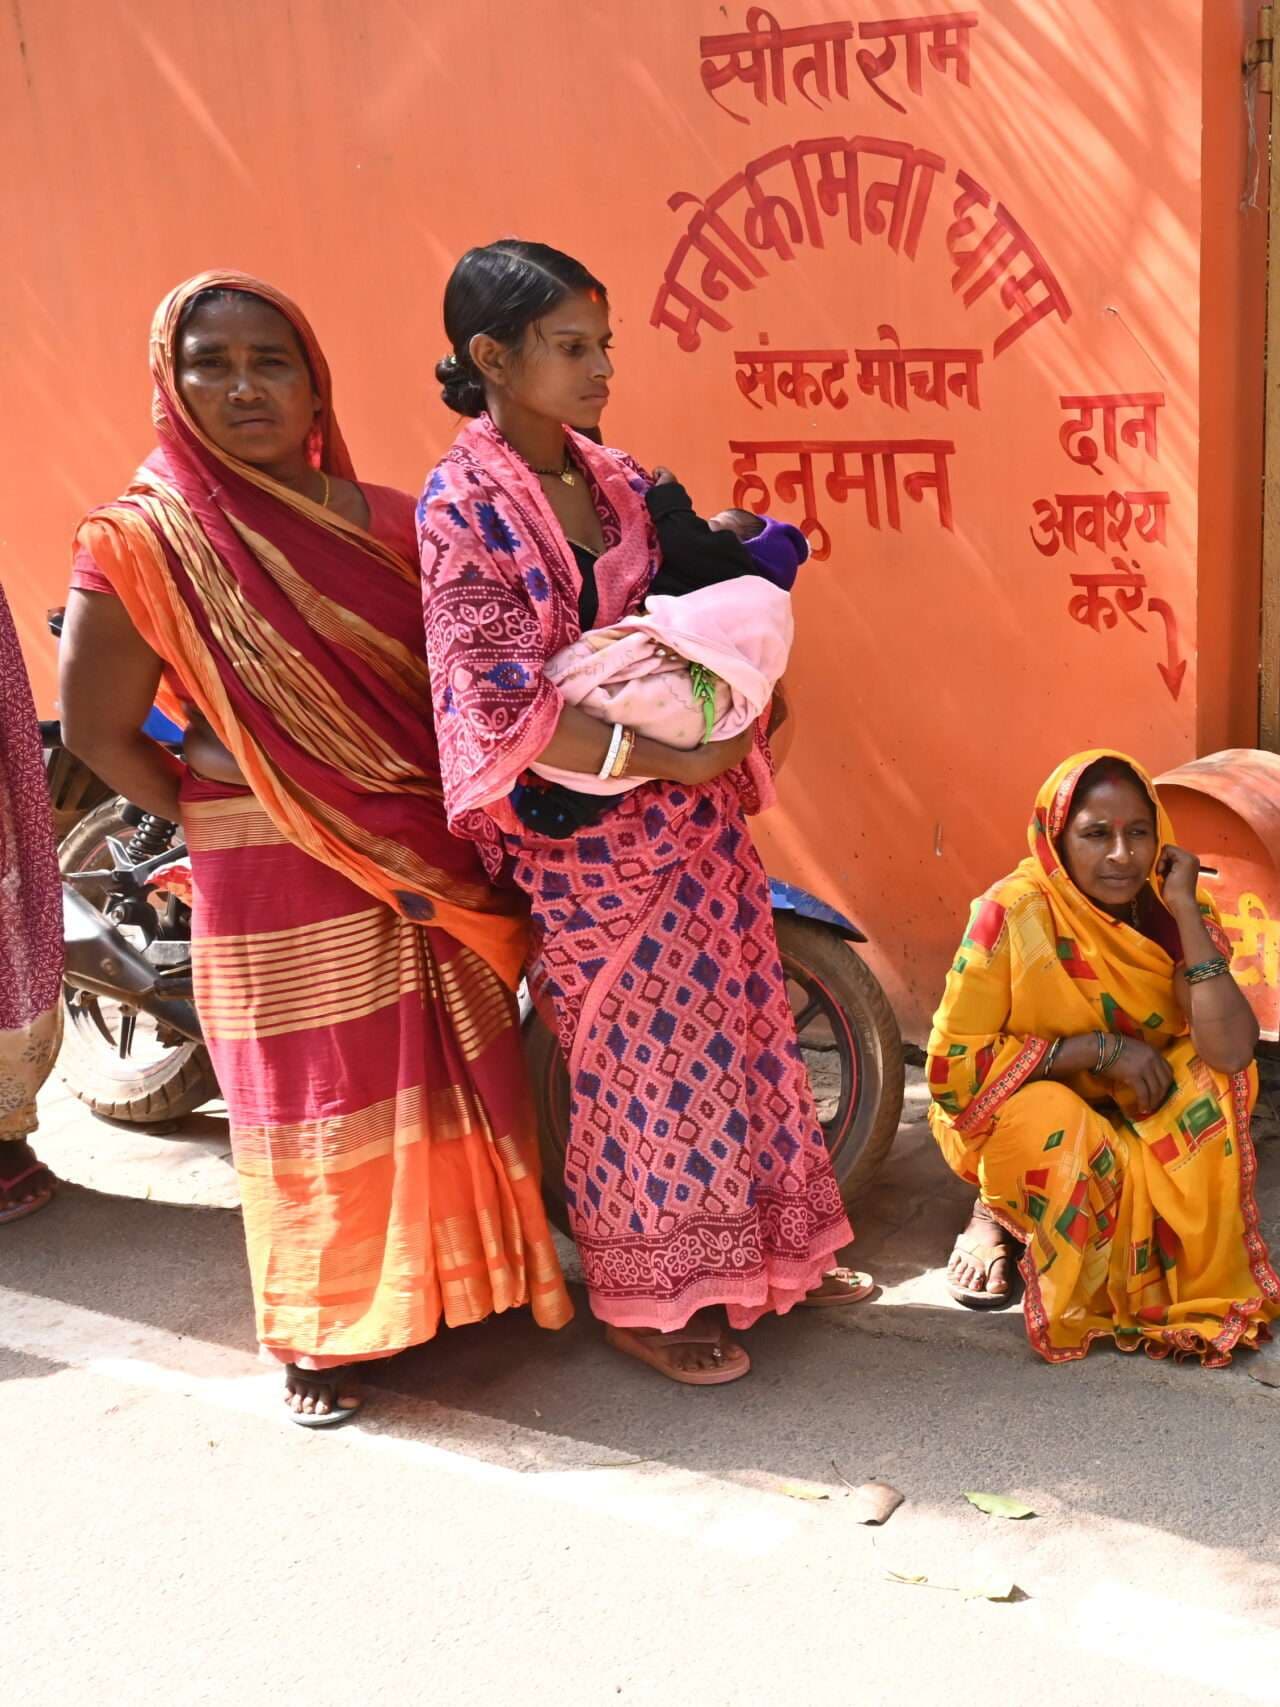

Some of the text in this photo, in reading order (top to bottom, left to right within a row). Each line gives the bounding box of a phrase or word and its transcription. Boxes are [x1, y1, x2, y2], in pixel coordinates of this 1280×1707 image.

[649, 136, 1073, 359] मनोकामना धाम
[734, 324, 984, 412] संकट मोचन
[1058, 392, 1166, 475] दान
[729, 439, 956, 561] हनुमान
[1029, 489, 1170, 557] अवश्य
[1068, 556, 1149, 633] करें
